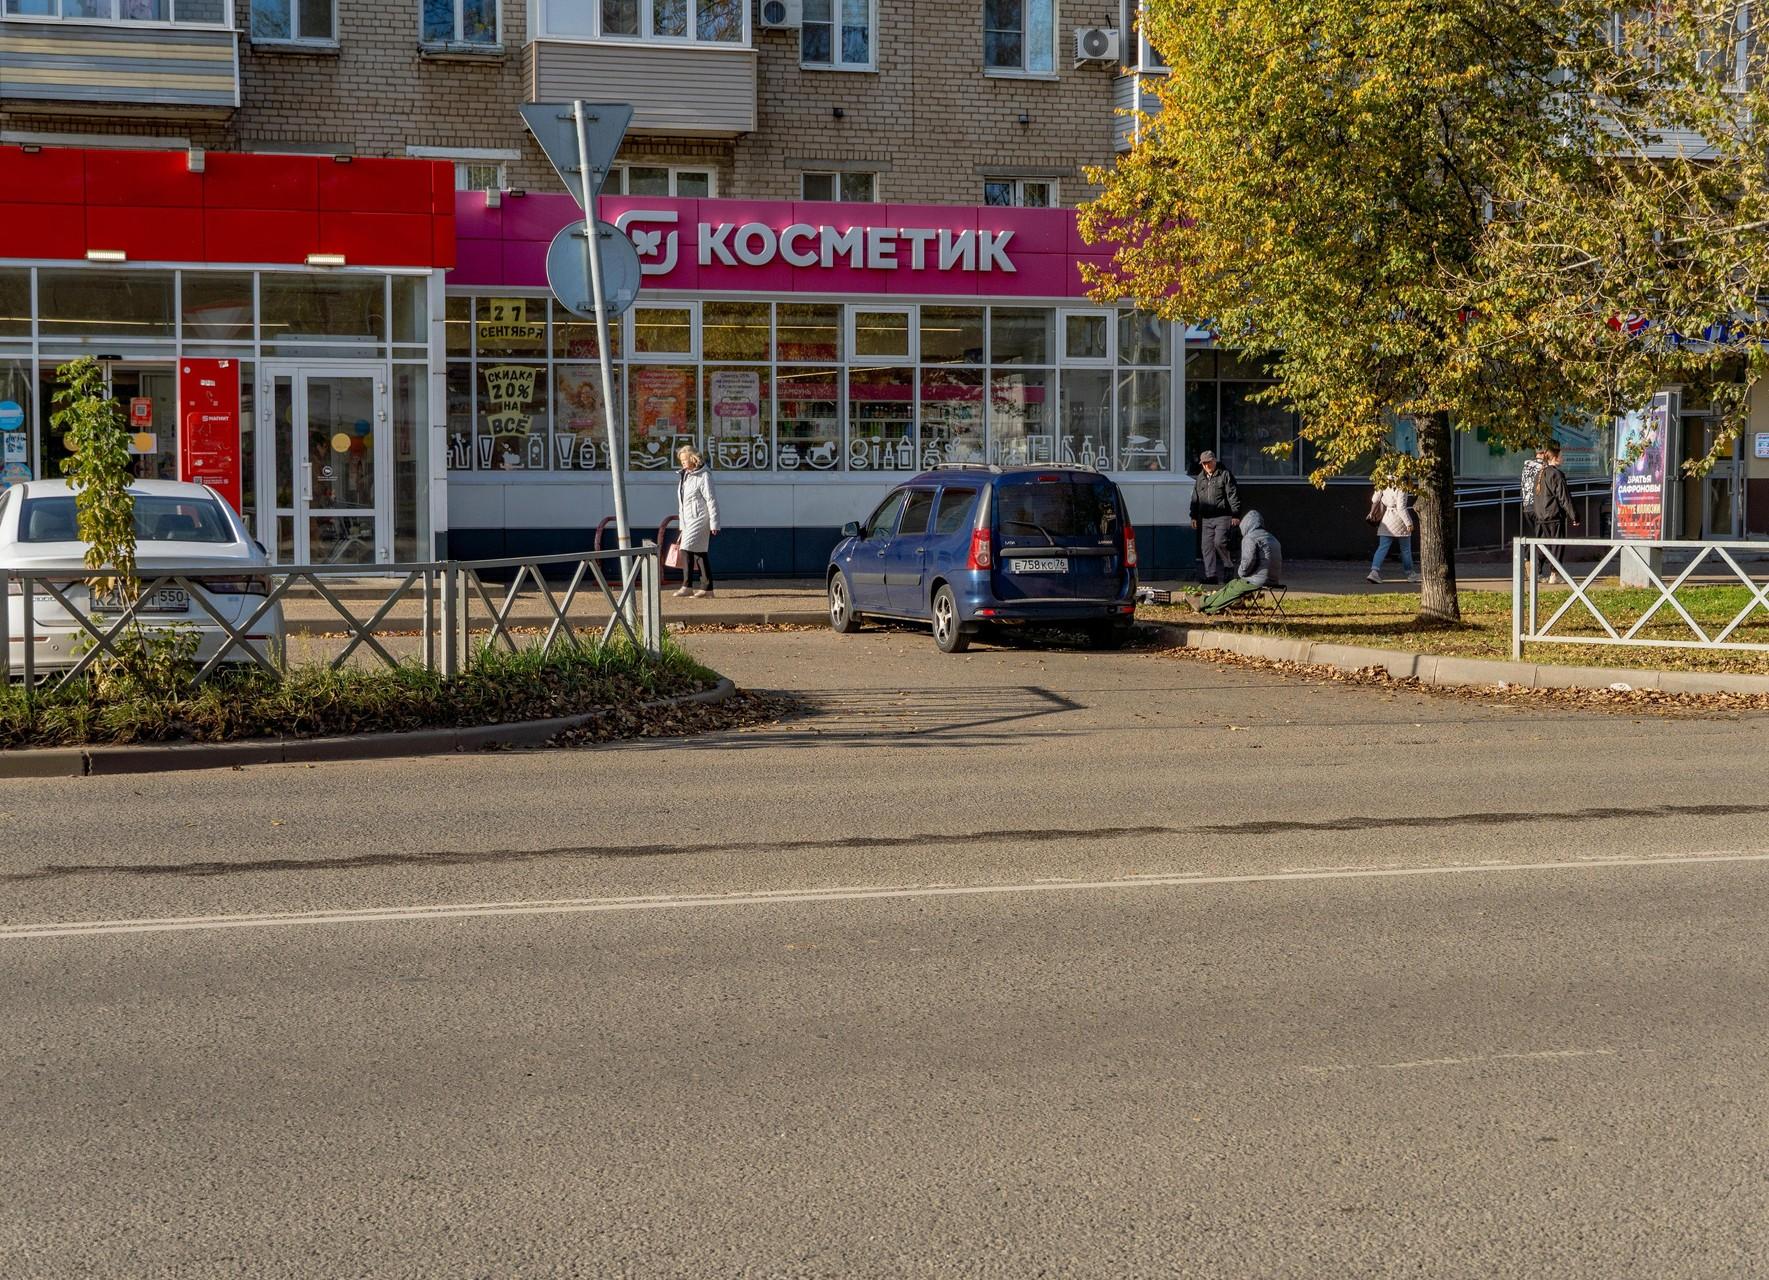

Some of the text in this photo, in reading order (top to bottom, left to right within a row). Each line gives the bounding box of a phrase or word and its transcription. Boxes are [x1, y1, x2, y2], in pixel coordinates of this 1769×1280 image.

[698, 222, 1017, 273] КОСМЕТИК
[480, 325, 544, 340] СЕНТЯБРЯ
[487, 370, 533, 383] СКИДКА
[491, 382, 531, 400] 20%
[503, 401, 519, 411] НА
[491, 414, 531, 435] ВСЁ
[1617, 484, 1661, 494] САФРОНОВЫ
[1055, 559, 1065, 568] 76
[159, 590, 184, 602] 550
